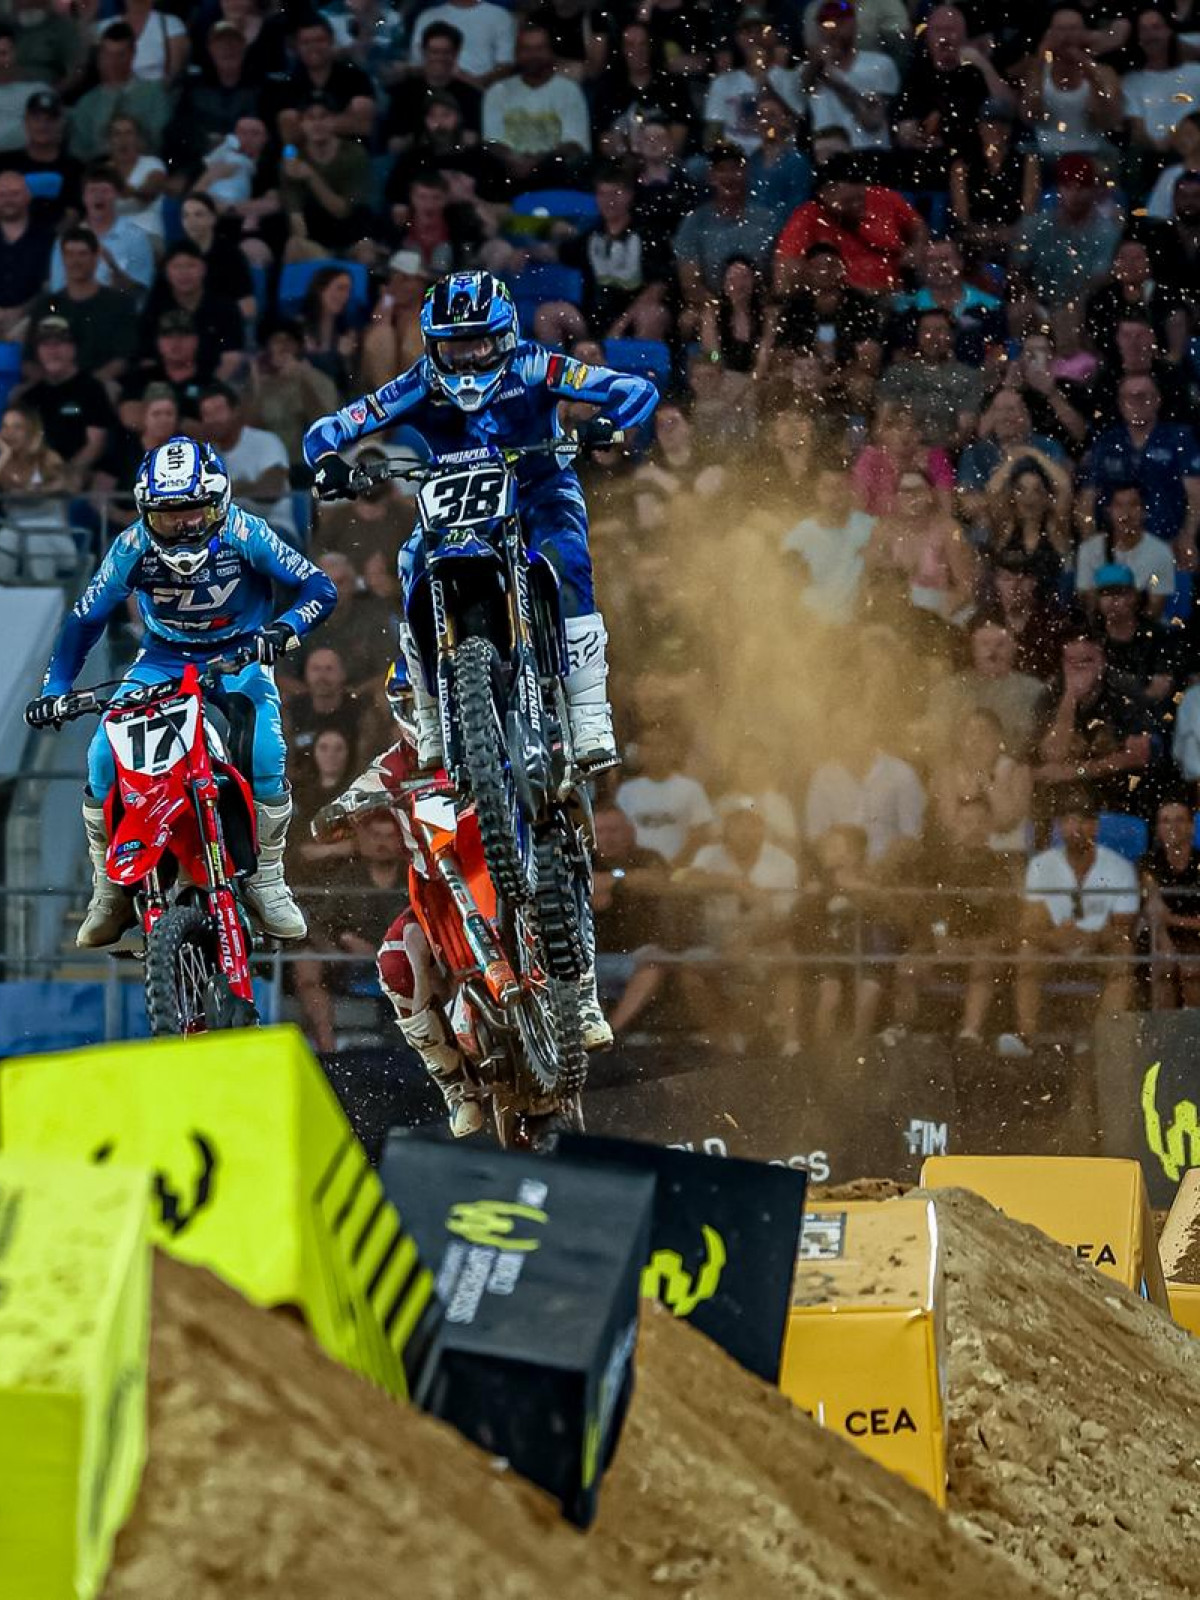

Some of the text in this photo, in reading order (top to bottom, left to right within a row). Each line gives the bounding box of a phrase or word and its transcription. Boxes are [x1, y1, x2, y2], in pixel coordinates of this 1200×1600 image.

[428, 471, 503, 528] 38
[153, 577, 242, 612] FLY
[525, 664, 542, 731] DUNLOP
[127, 709, 188, 771] 17
[905, 1118, 948, 1155] FIM
[1065, 1243, 1117, 1267] EA
[845, 1407, 917, 1436] CEA
